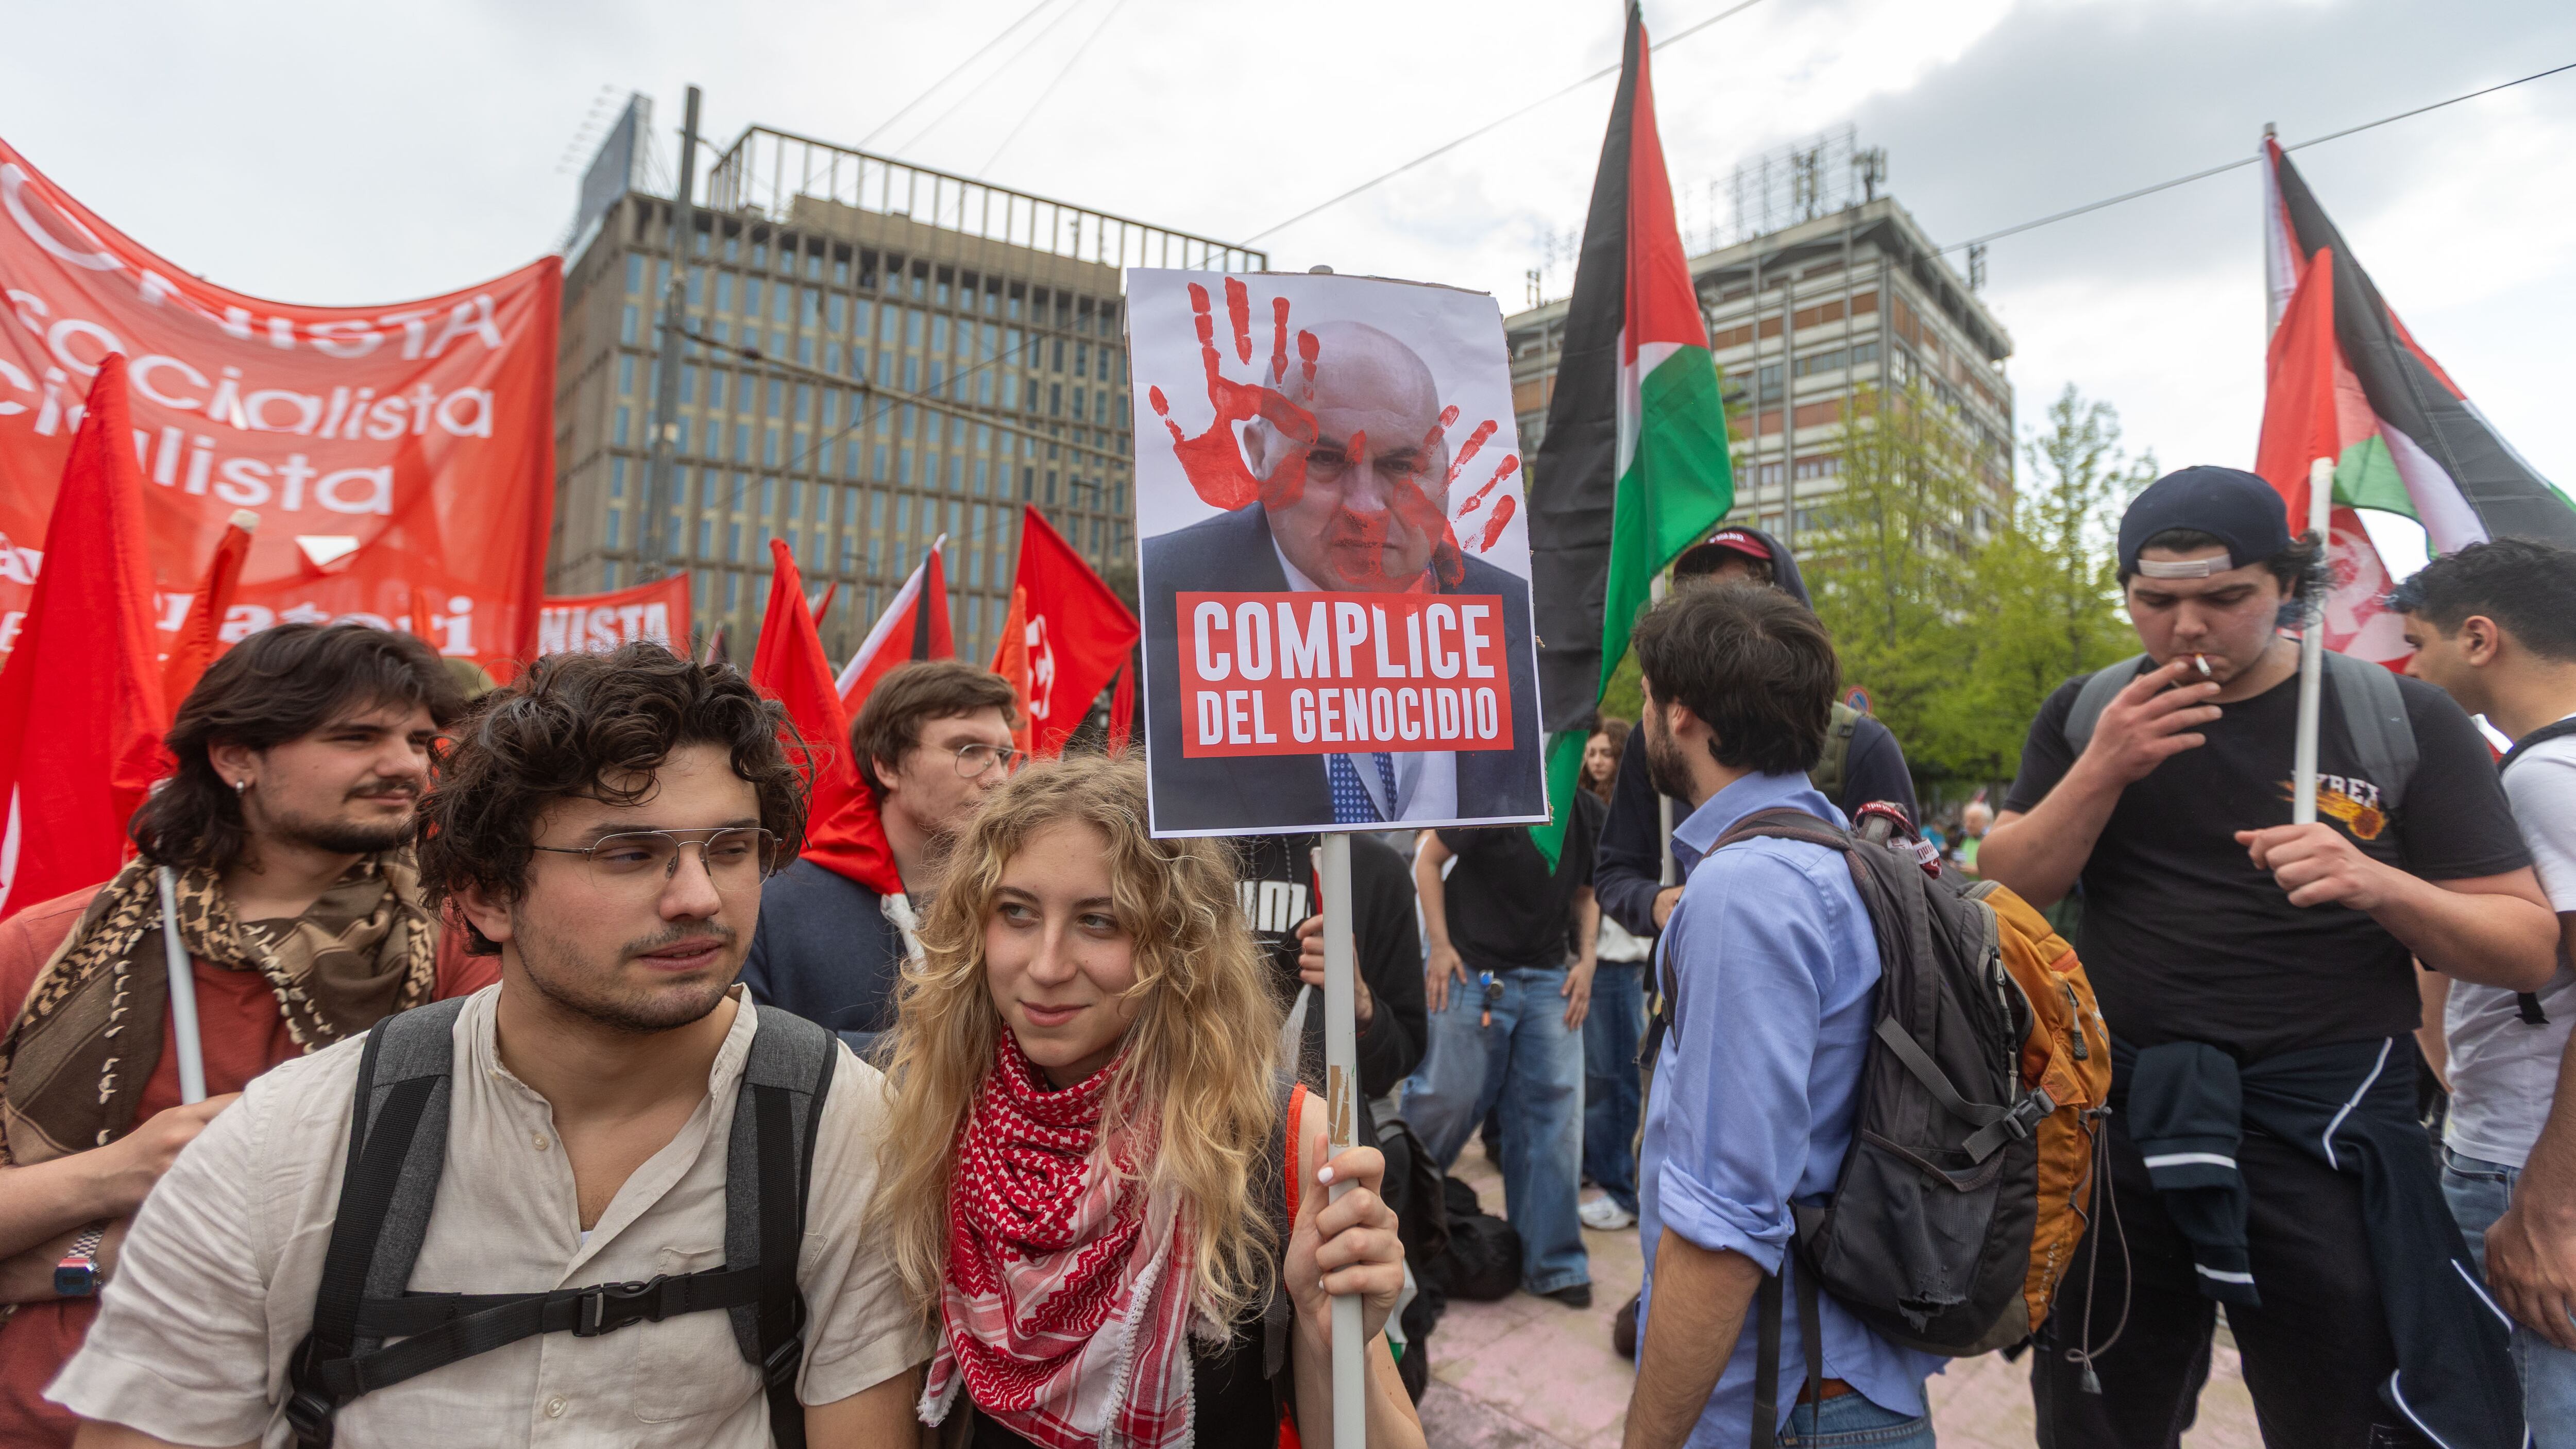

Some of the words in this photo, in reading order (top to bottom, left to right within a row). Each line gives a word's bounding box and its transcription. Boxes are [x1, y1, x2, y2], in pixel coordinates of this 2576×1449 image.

[1194, 601, 1495, 681] COMPLICE
[1197, 690, 1277, 745] DEL
[1291, 687, 1498, 742] GENOCIDIO
